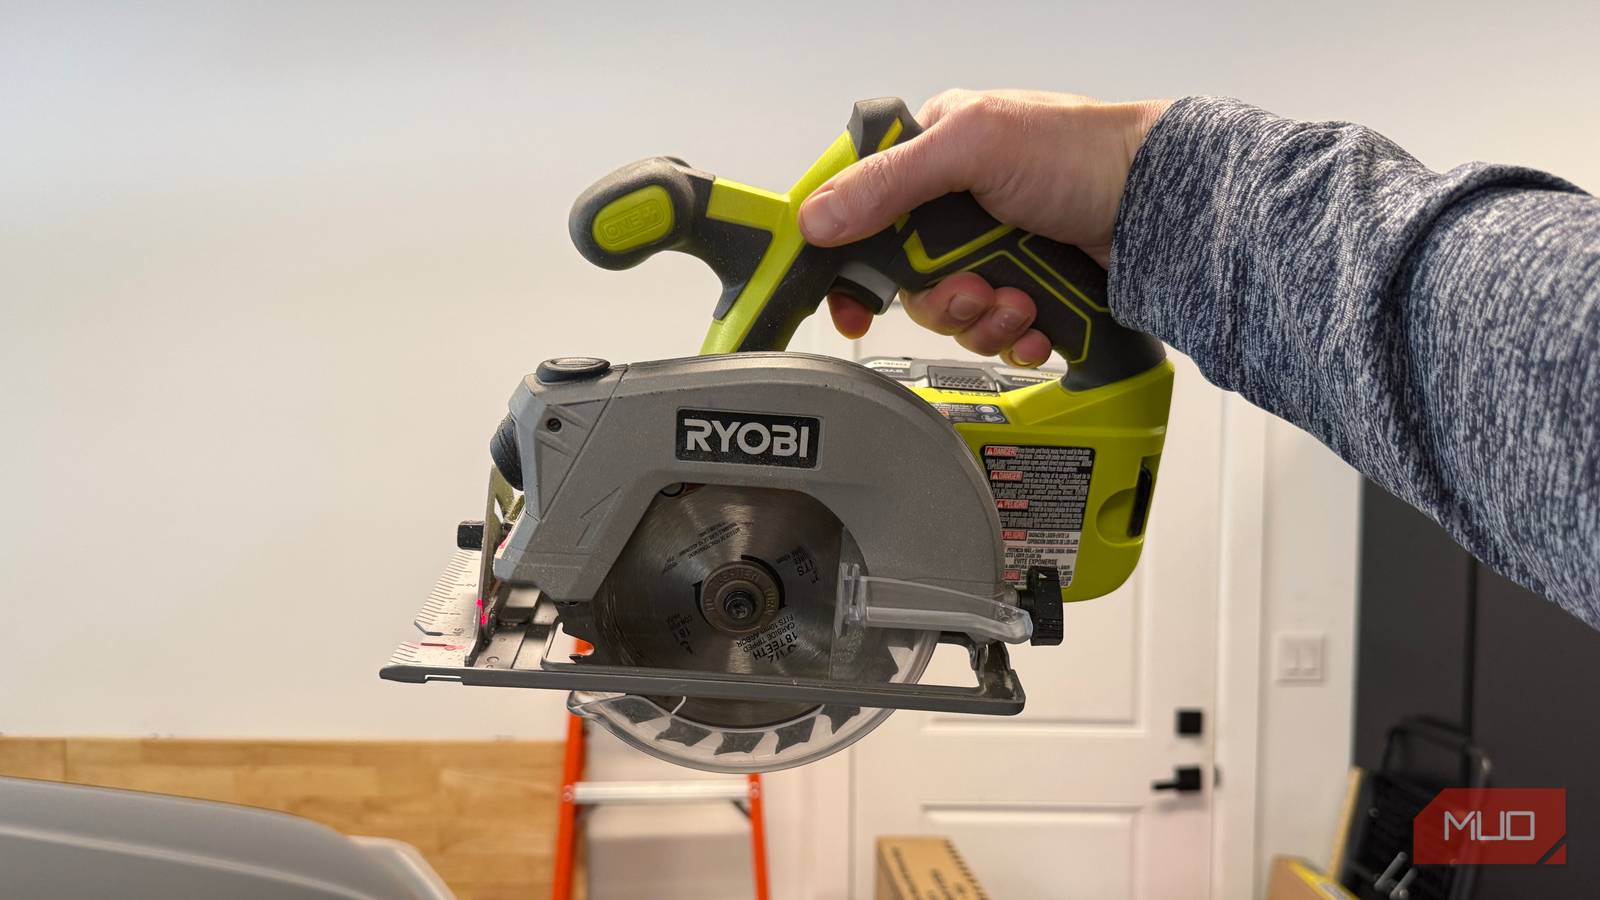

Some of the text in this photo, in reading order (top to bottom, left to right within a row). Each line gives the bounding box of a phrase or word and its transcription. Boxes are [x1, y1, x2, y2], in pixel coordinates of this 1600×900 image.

[684, 418, 809, 458] RYOBI
[752, 631, 798, 661] 18 TEETH
